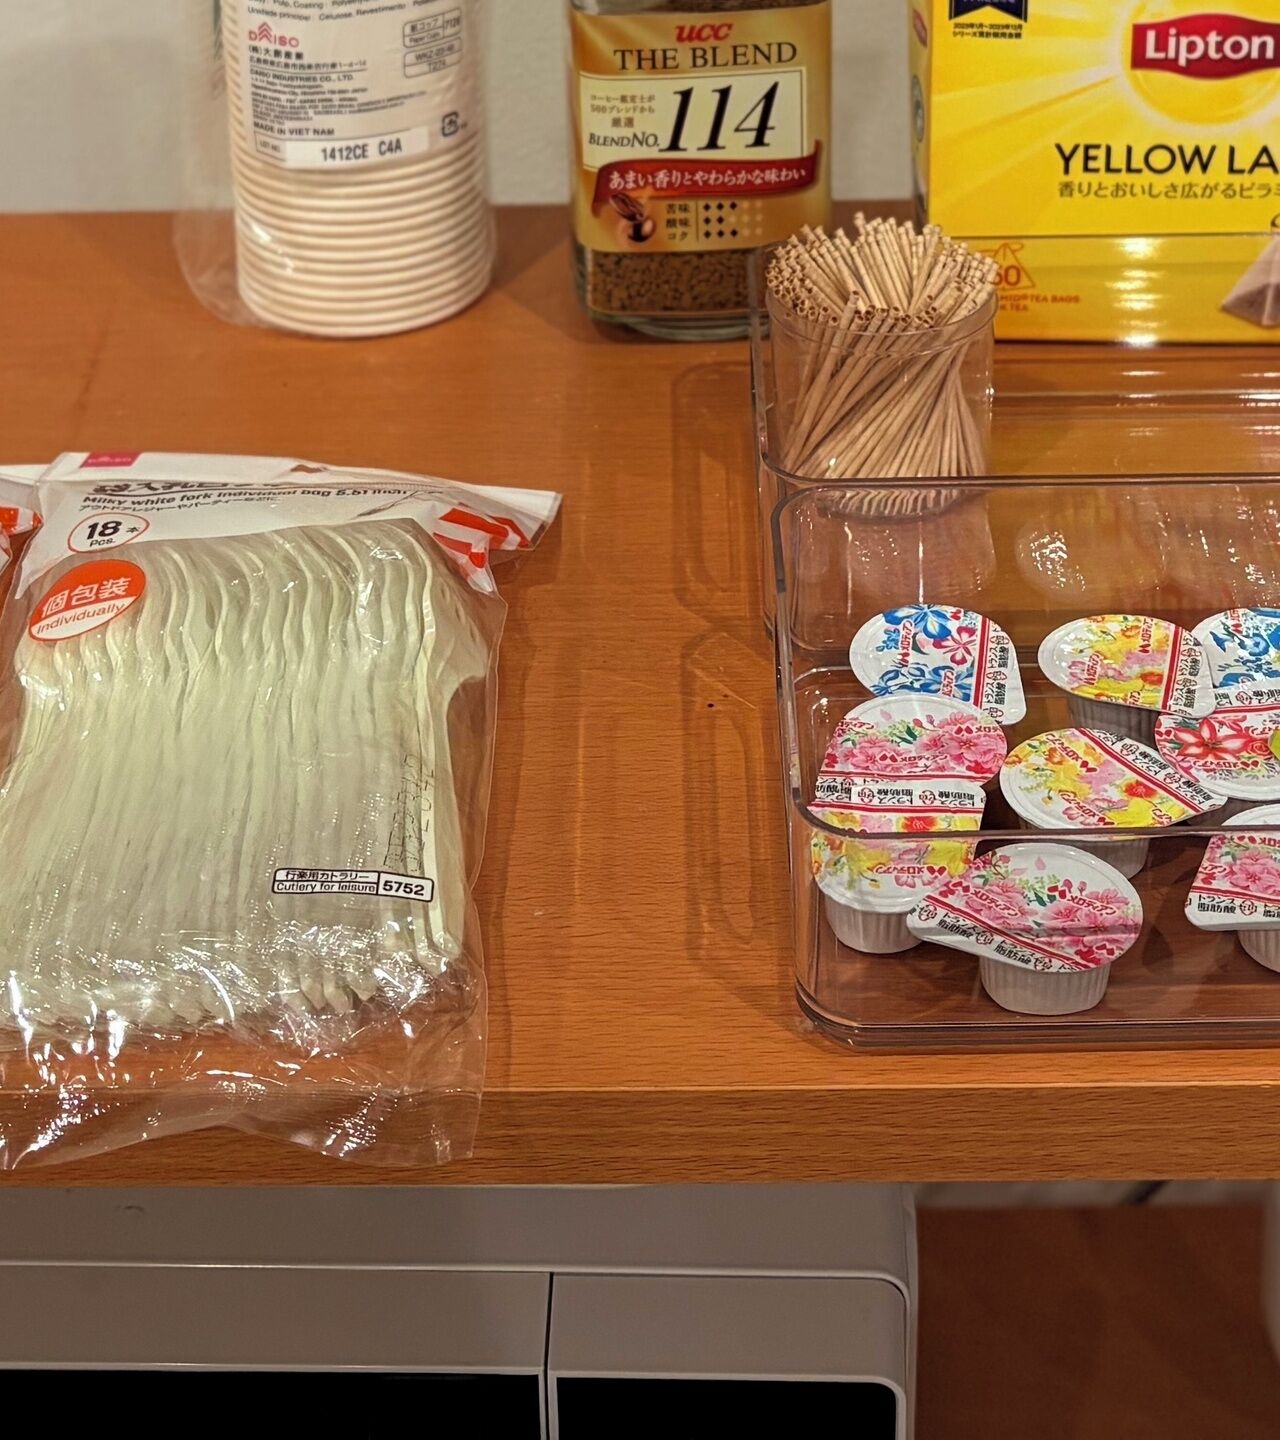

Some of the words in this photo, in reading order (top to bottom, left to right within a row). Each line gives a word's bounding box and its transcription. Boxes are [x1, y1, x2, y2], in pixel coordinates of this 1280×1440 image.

[613, 47, 680, 71] THE
[689, 41, 797, 70] BLEND
[1145, 28, 1275, 68] Lipton
[253, 120, 275, 134] MADE
[277, 126, 286, 135] IN
[289, 127, 310, 136] VIET
[313, 127, 335, 136] NAM
[658, 81, 780, 153] 114
[321, 143, 369, 162] 1412CE
[378, 138, 403, 156] C4A
[588, 131, 631, 148] BLEND
[1055, 143, 1216, 176] YELLOW
[608, 167, 807, 191] あまい香りとやわらかな味わい
[667, 230, 689, 241] コク
[82, 496, 128, 506] Milky
[131, 495, 176, 506] white
[180, 492, 214, 502] fork
[86, 520, 123, 540] 18
[89, 537, 117, 548] Pcs.
[41, 576, 132, 619] 個包装
[36, 603, 126, 635] Individually
[901, 620, 913, 652] メロディアン
[284, 870, 371, 881] 行楽用カトラリー
[276, 881, 317, 894] Cutlery
[320, 881, 335, 892] for
[337, 882, 376, 893] leisure
[382, 879, 425, 897] 5752
[971, 889, 1020, 918] メロディアン
[1068, 894, 1117, 916] メロディアン
